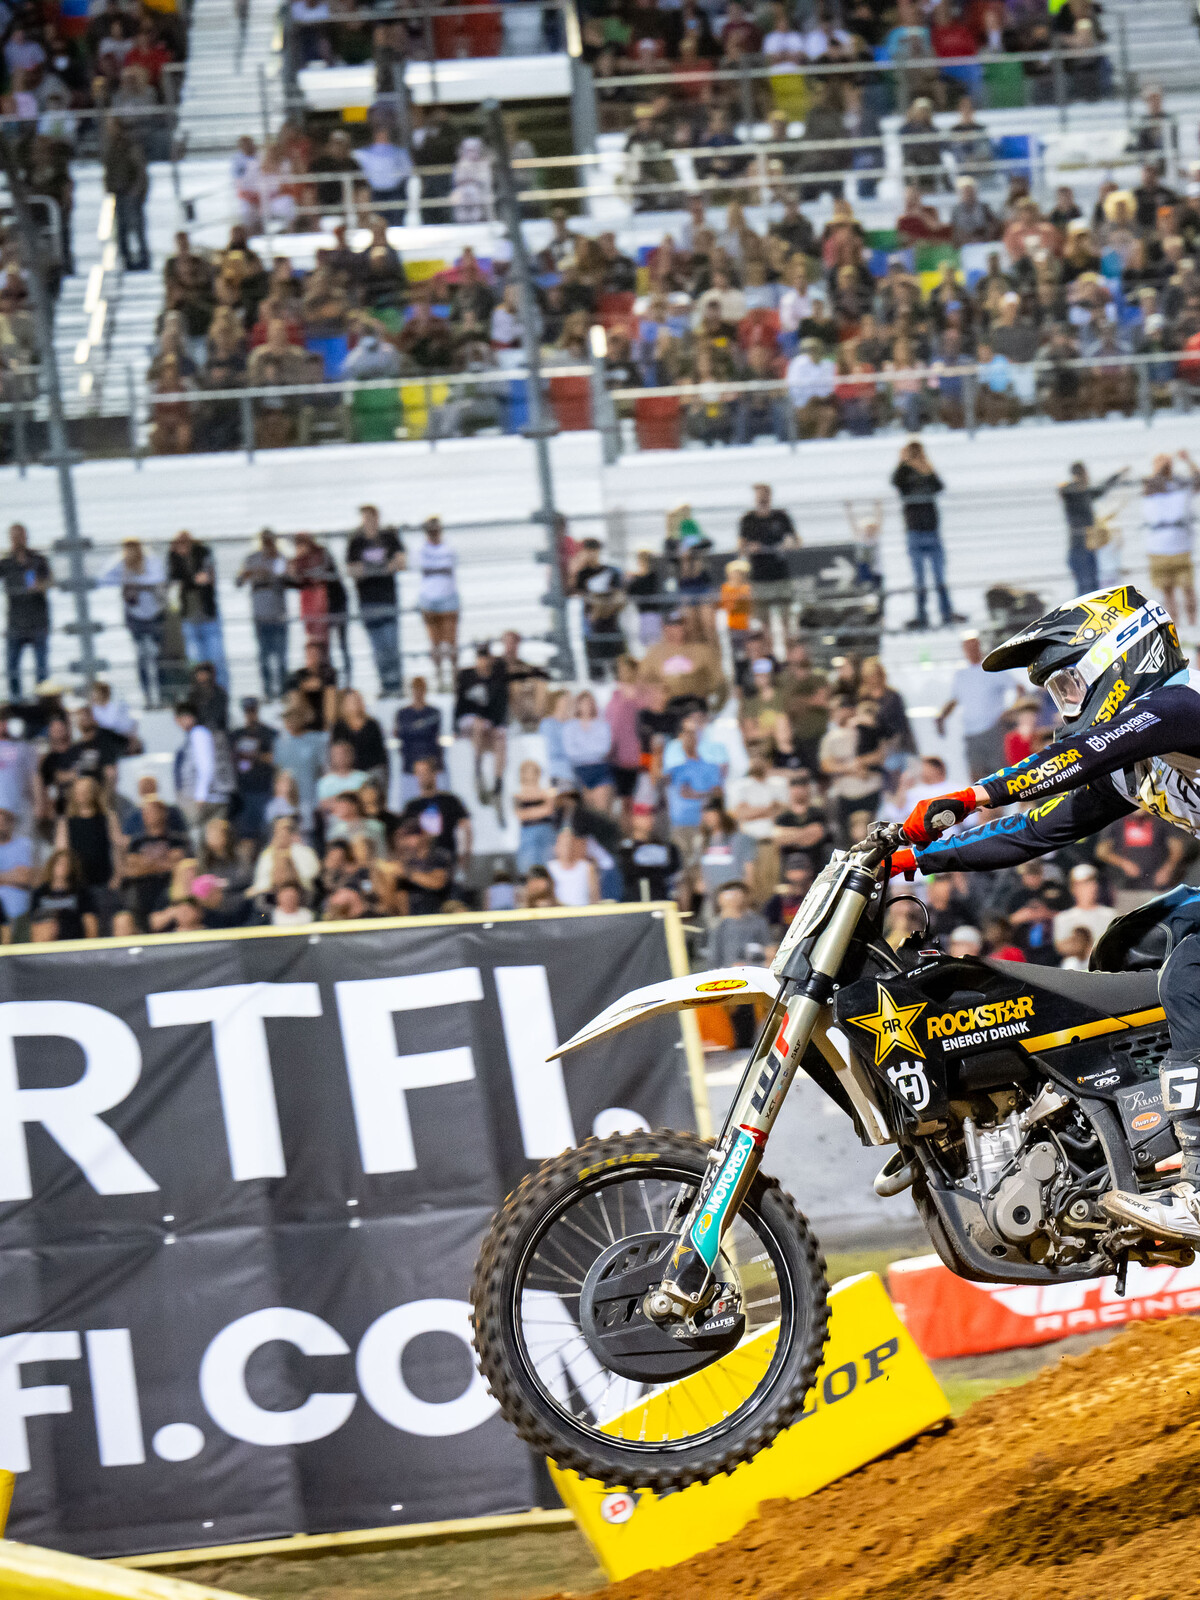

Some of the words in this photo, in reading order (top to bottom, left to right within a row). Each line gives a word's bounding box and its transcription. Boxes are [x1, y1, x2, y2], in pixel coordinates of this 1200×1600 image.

[1101, 711, 1155, 744] Husqvarna
[1006, 748, 1083, 795] ROCKSTAR
[1019, 778, 1055, 799] ENERGY
[1055, 762, 1083, 783] DRINK
[926, 995, 1036, 1040] ROCKSTAR
[941, 1030, 989, 1052] ENERGY
[990, 1020, 1031, 1041] DRINK
[1135, 1118, 1149, 1128] Twin
[1148, 1115, 1159, 1124] Air
[705, 1140, 751, 1214] MOTOREX
[704, 1316, 735, 1331] GALFER
